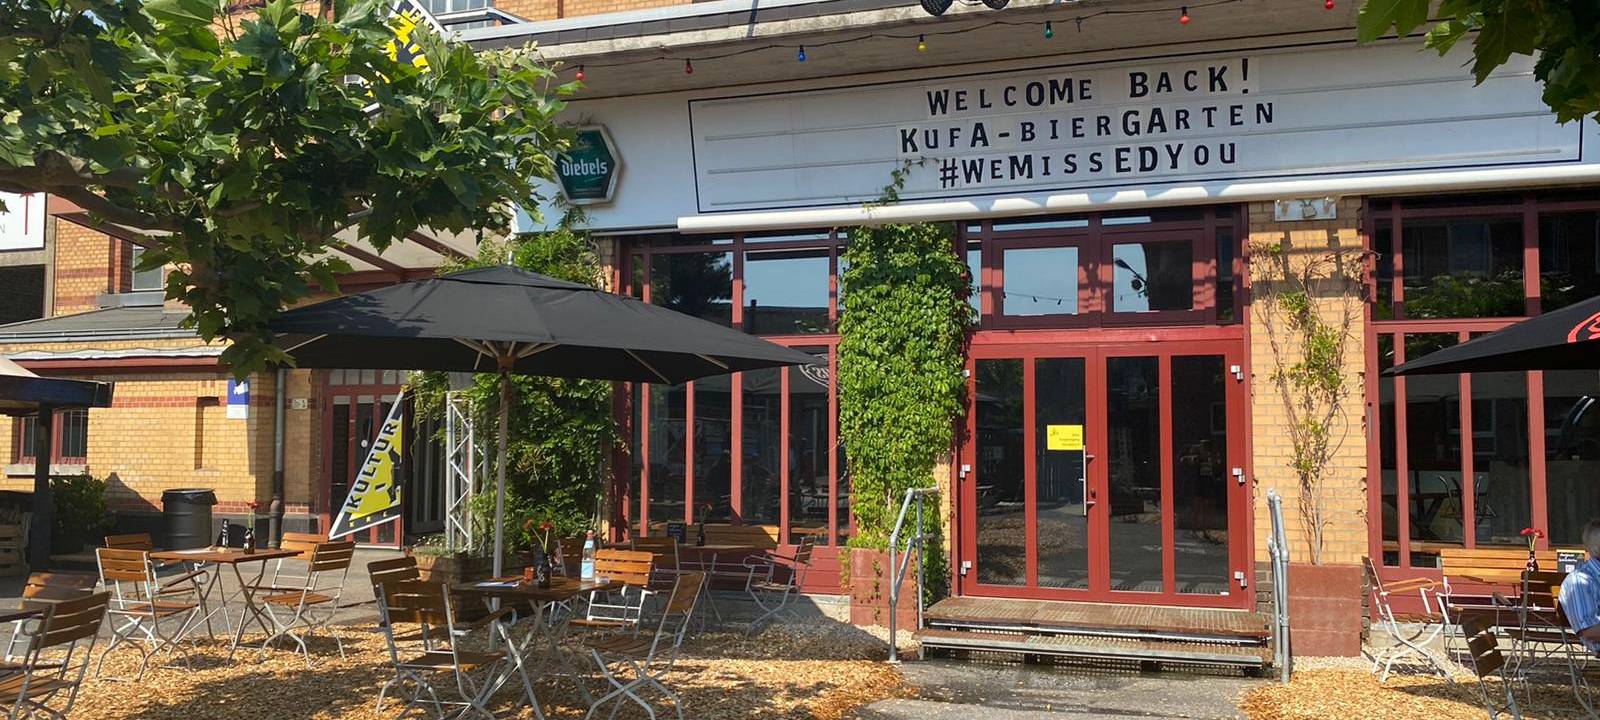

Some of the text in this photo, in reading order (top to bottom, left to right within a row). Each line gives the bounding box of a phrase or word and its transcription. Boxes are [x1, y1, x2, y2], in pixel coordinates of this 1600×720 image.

[927, 58, 1249, 115] WELCOME BACK!
[900, 103, 1273, 153] KUFA-BIERGARTEN
[560, 158, 608, 176] Diebels
[940, 143, 1236, 188] #WEMISSEDYOU
[346, 422, 398, 509] KULTUR
